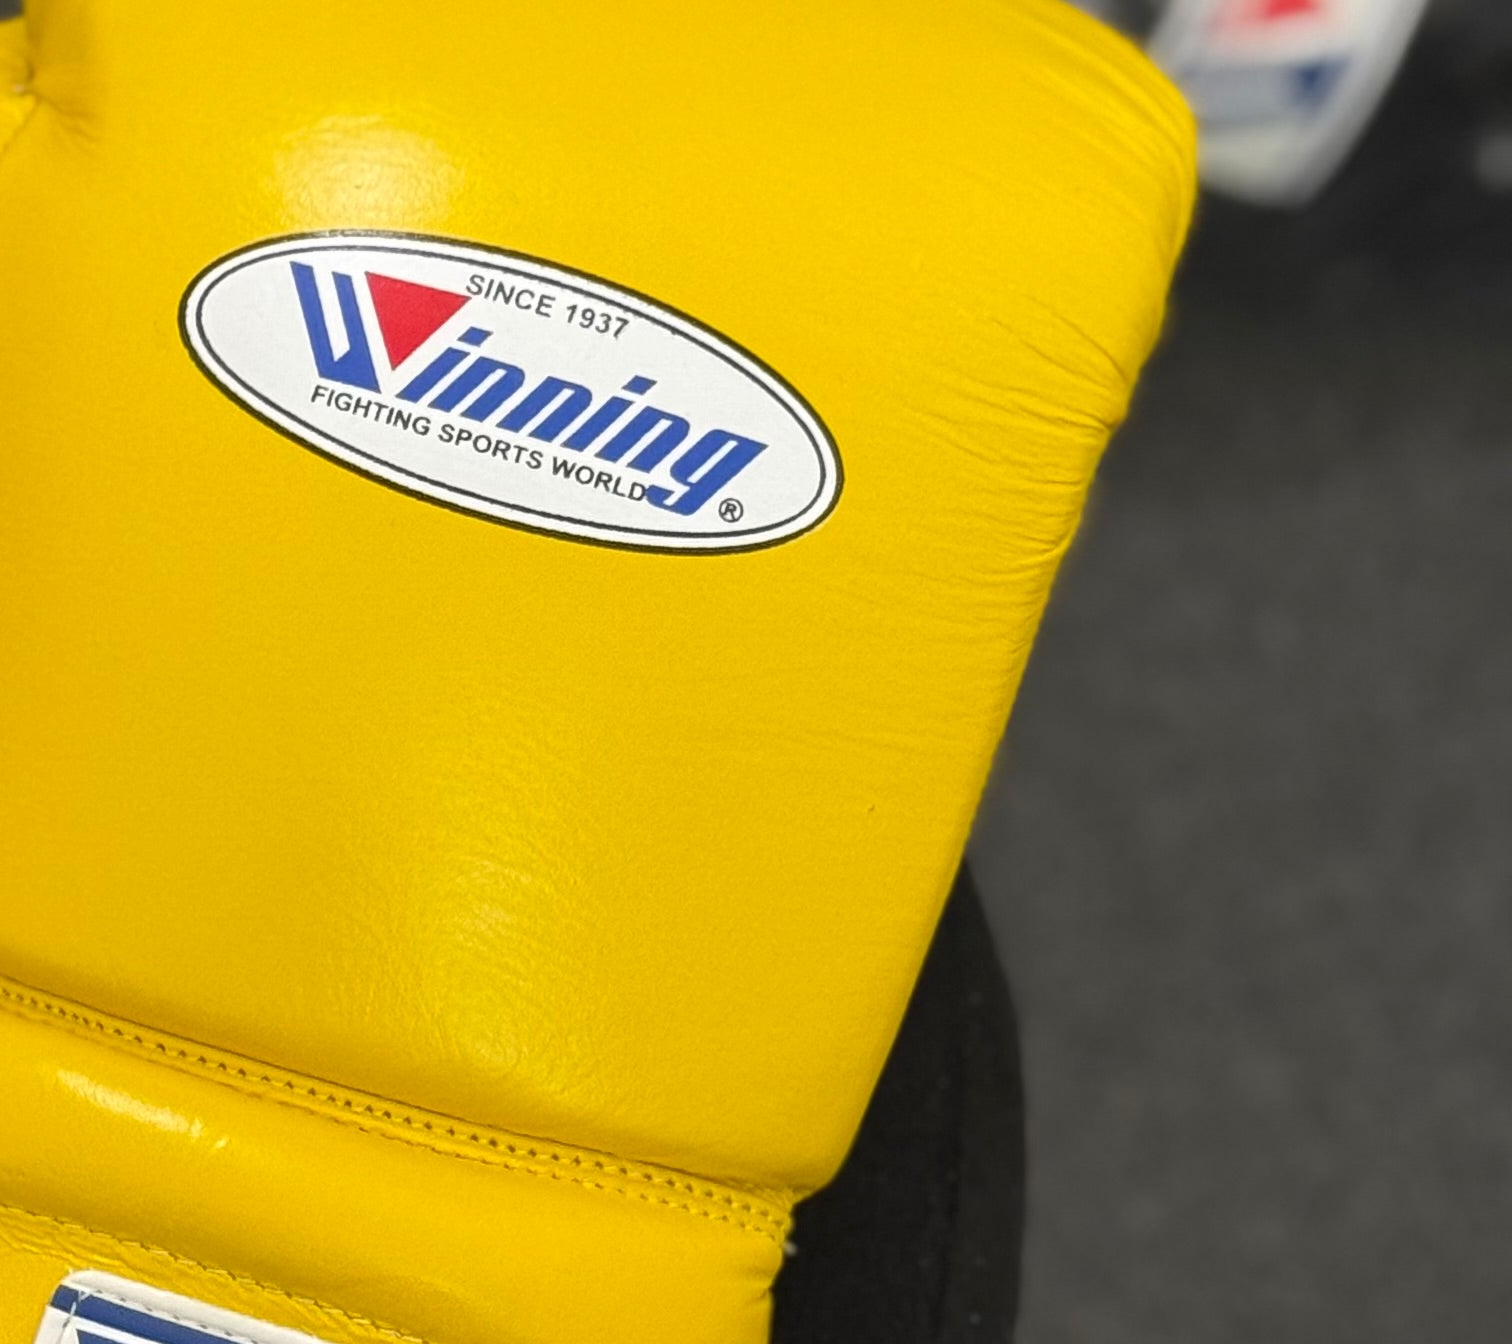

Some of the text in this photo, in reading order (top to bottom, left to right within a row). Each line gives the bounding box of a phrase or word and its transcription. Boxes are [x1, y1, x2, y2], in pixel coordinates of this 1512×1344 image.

[465, 273, 630, 339] SINCE 1937
[289, 260, 769, 517] Winning
[310, 384, 648, 504] FIGHTING SPORTS WORLD
